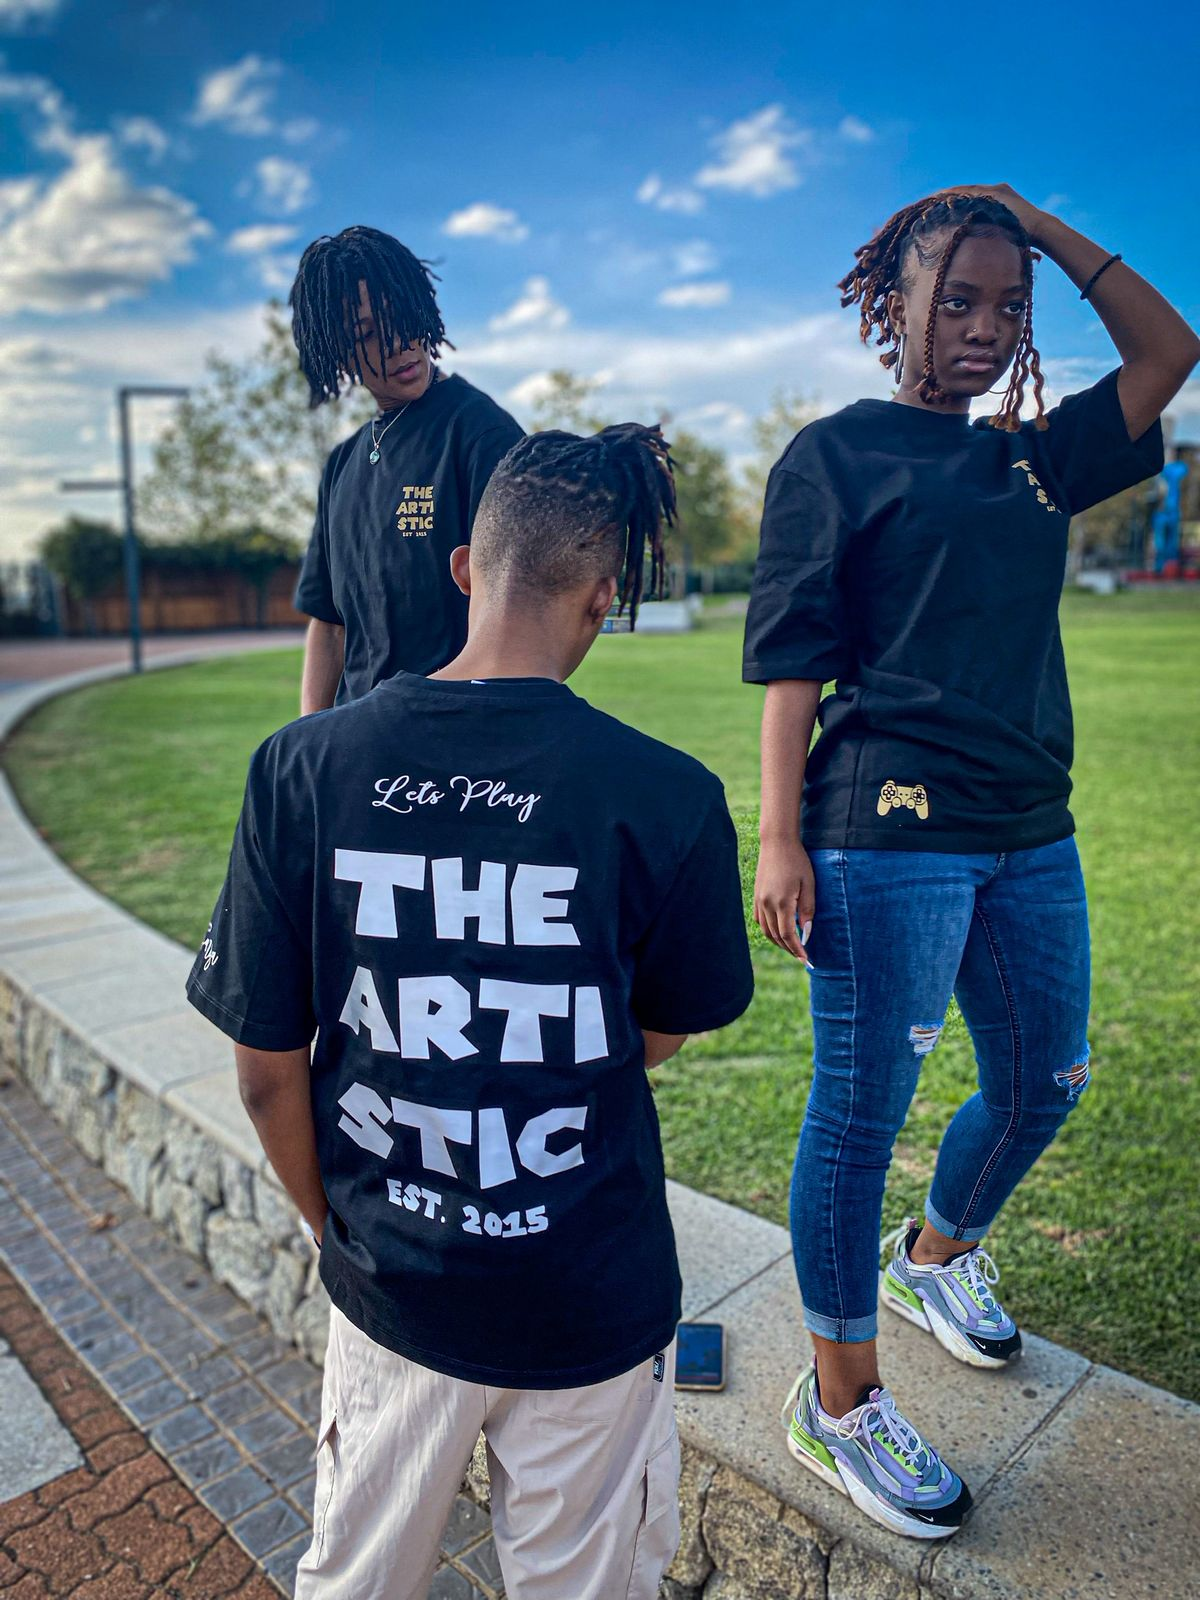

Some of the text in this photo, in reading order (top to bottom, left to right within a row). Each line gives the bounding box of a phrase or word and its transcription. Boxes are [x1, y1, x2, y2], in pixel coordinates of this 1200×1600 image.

[395, 500, 435, 515] ARTI
[402, 486, 434, 499] THE
[397, 516, 434, 531] STIC
[371, 775, 541, 823] Lets Play
[334, 848, 581, 946] THE
[339, 965, 609, 1064] ARTI
[337, 1081, 588, 1190] STIC
[386, 1178, 549, 1238] EST. 2015
